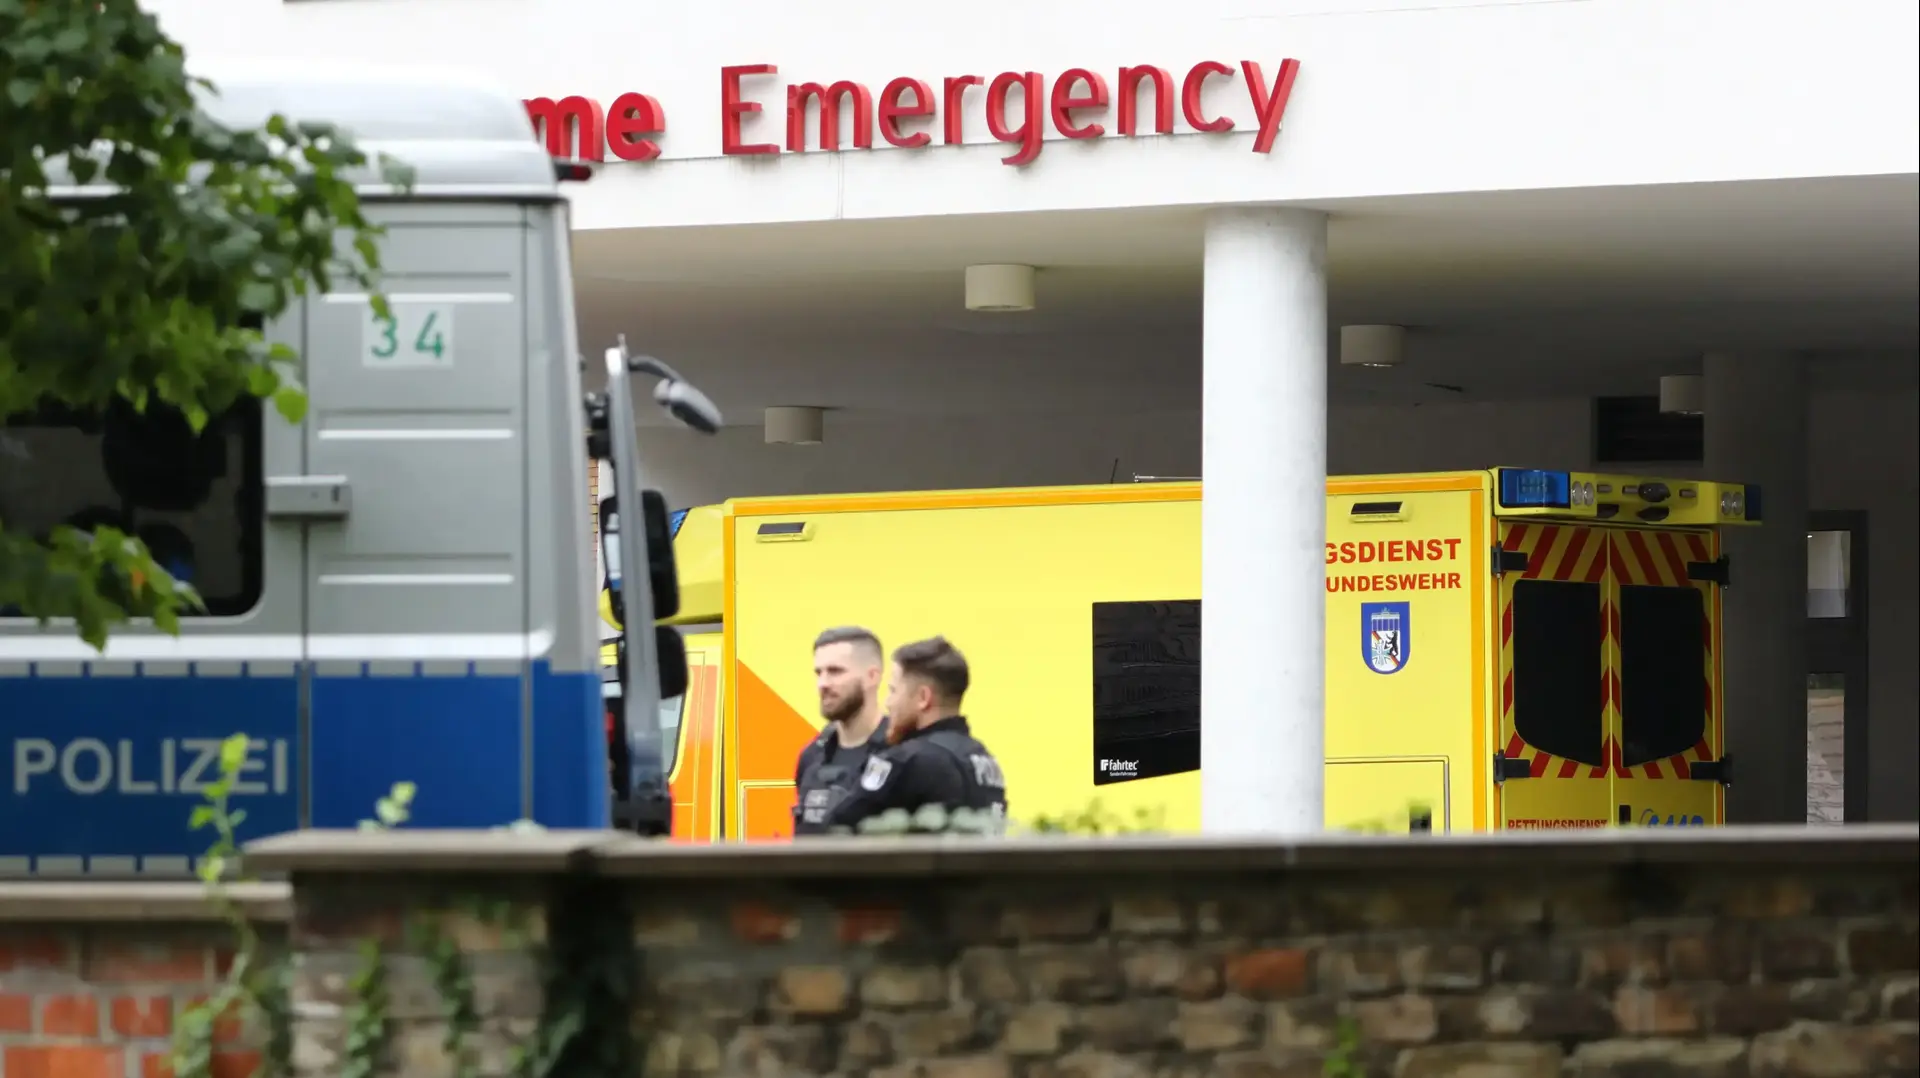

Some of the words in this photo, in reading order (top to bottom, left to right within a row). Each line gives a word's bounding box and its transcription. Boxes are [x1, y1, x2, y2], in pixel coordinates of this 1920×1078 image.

[721, 57, 1301, 167] Emergency
[1325, 572, 1462, 593] UNDESWEHR
[13, 737, 289, 795] POLIZEI
[1109, 759, 1138, 771] fahrtec
